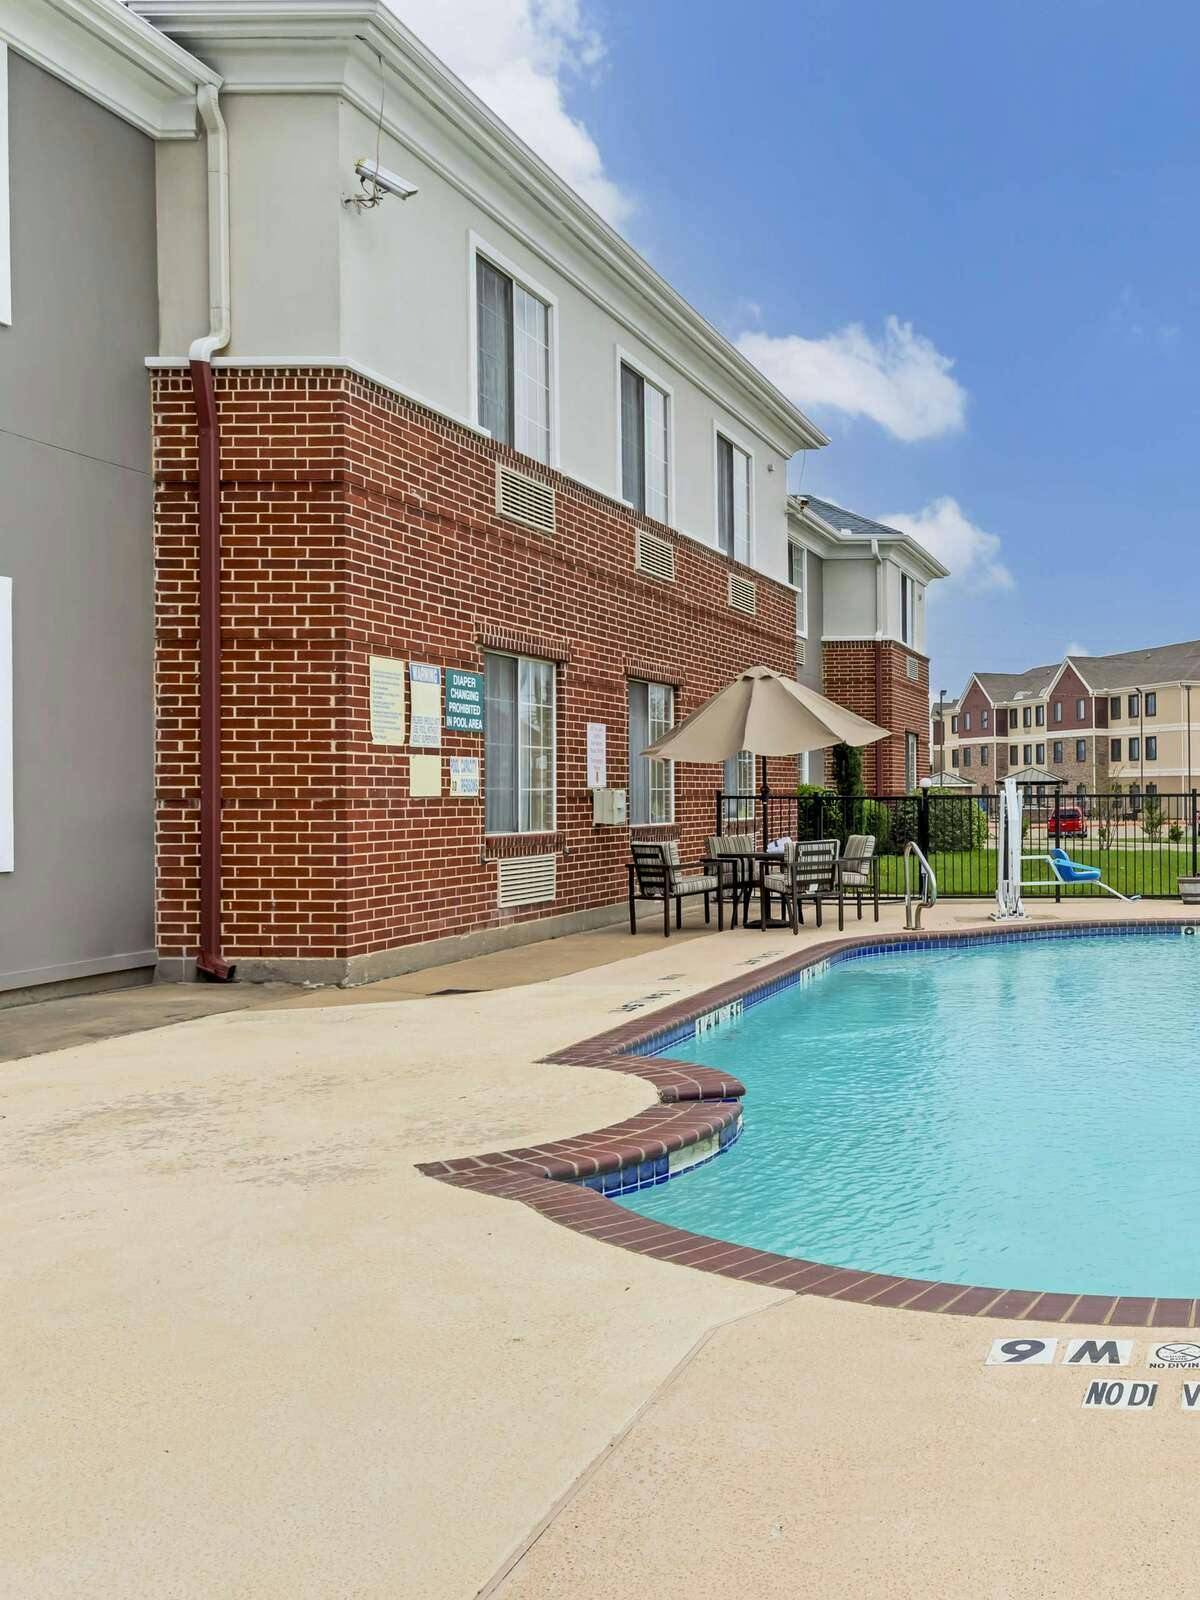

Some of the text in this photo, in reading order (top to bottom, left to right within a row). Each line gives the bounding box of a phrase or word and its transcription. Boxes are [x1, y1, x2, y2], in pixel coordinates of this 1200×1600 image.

[453, 674, 476, 688] DIAPER
[450, 687, 480, 702] CHANGING
[448, 701, 481, 716] PROHIBITED
[447, 715, 483, 730] IN POOL AREA
[1000, 1339, 1046, 1363] 9
[1068, 1340, 1121, 1364] M
[1085, 1381, 1124, 1407] NO
